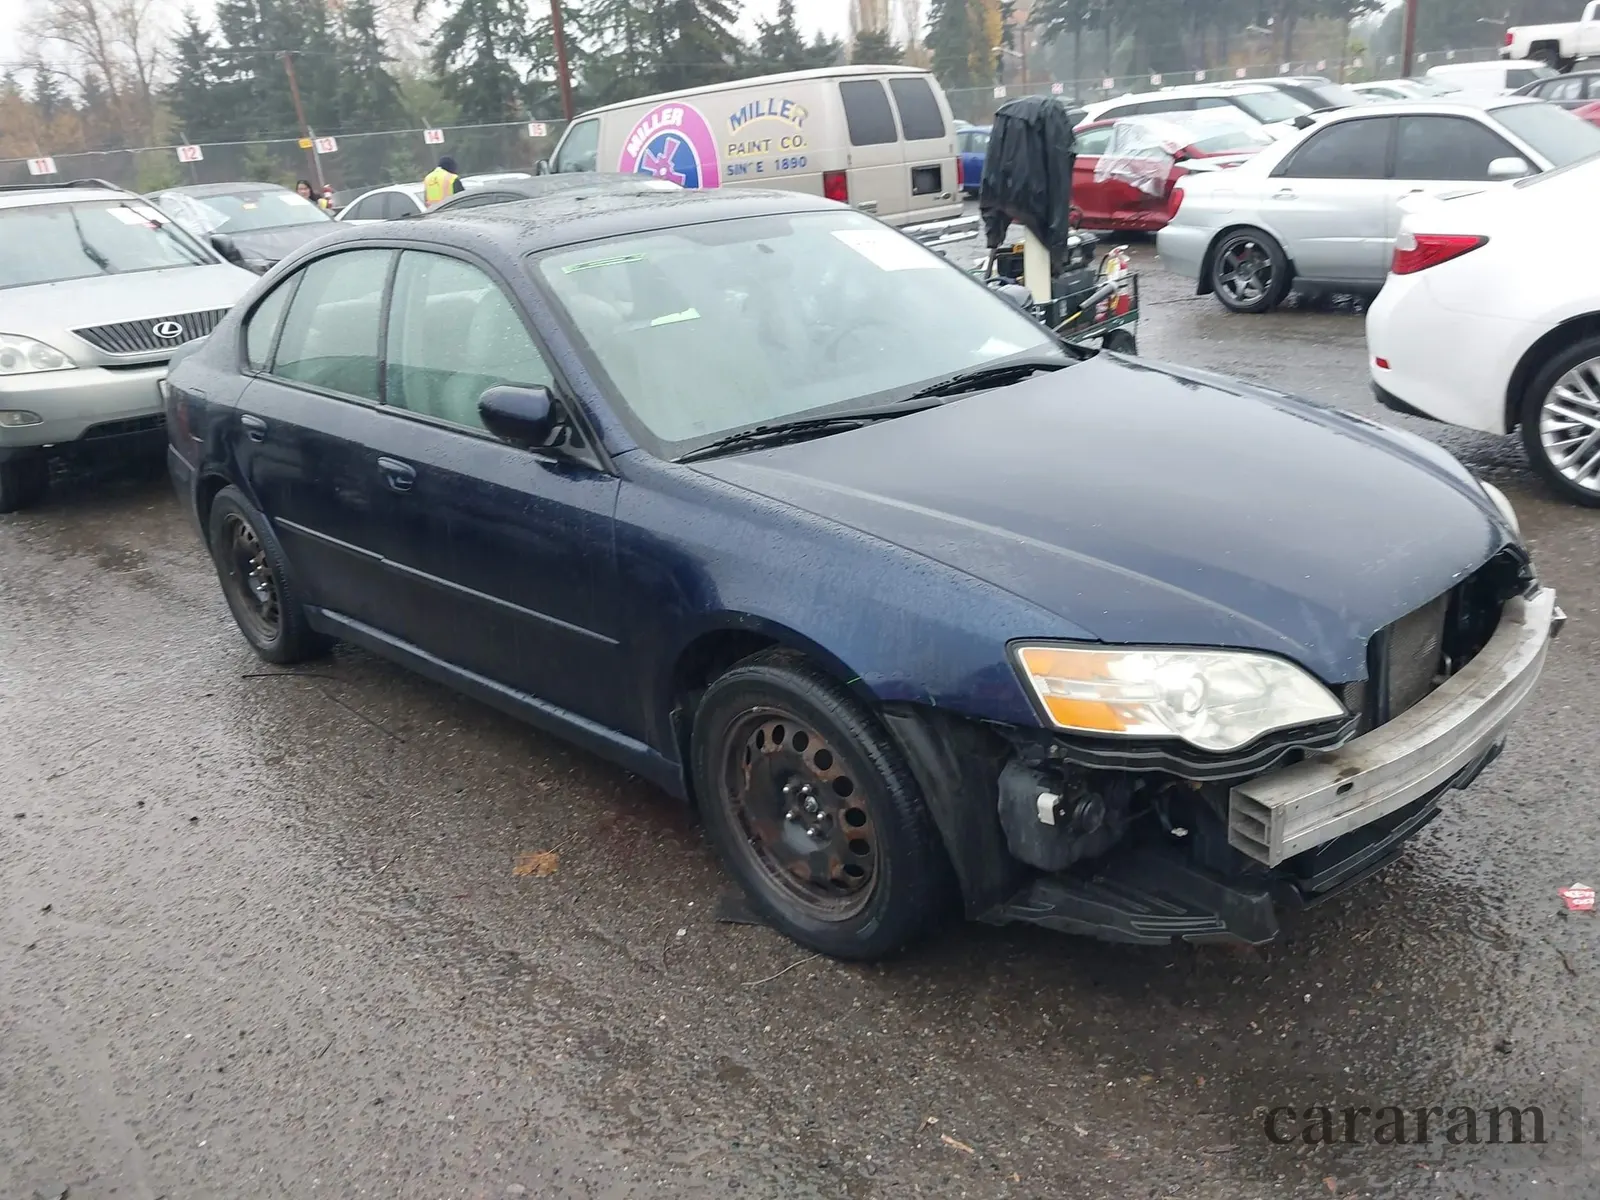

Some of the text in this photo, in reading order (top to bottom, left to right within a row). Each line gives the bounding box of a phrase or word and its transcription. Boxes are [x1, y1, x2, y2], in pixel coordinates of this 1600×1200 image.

[427, 131, 441, 142] 14
[626, 107, 684, 158] MILLER
[319, 137, 333, 151] 13
[727, 134, 808, 156] PAINT CO.
[182, 146, 199, 160] 12
[35, 159, 49, 173] 11
[774, 156, 808, 171] 1890
